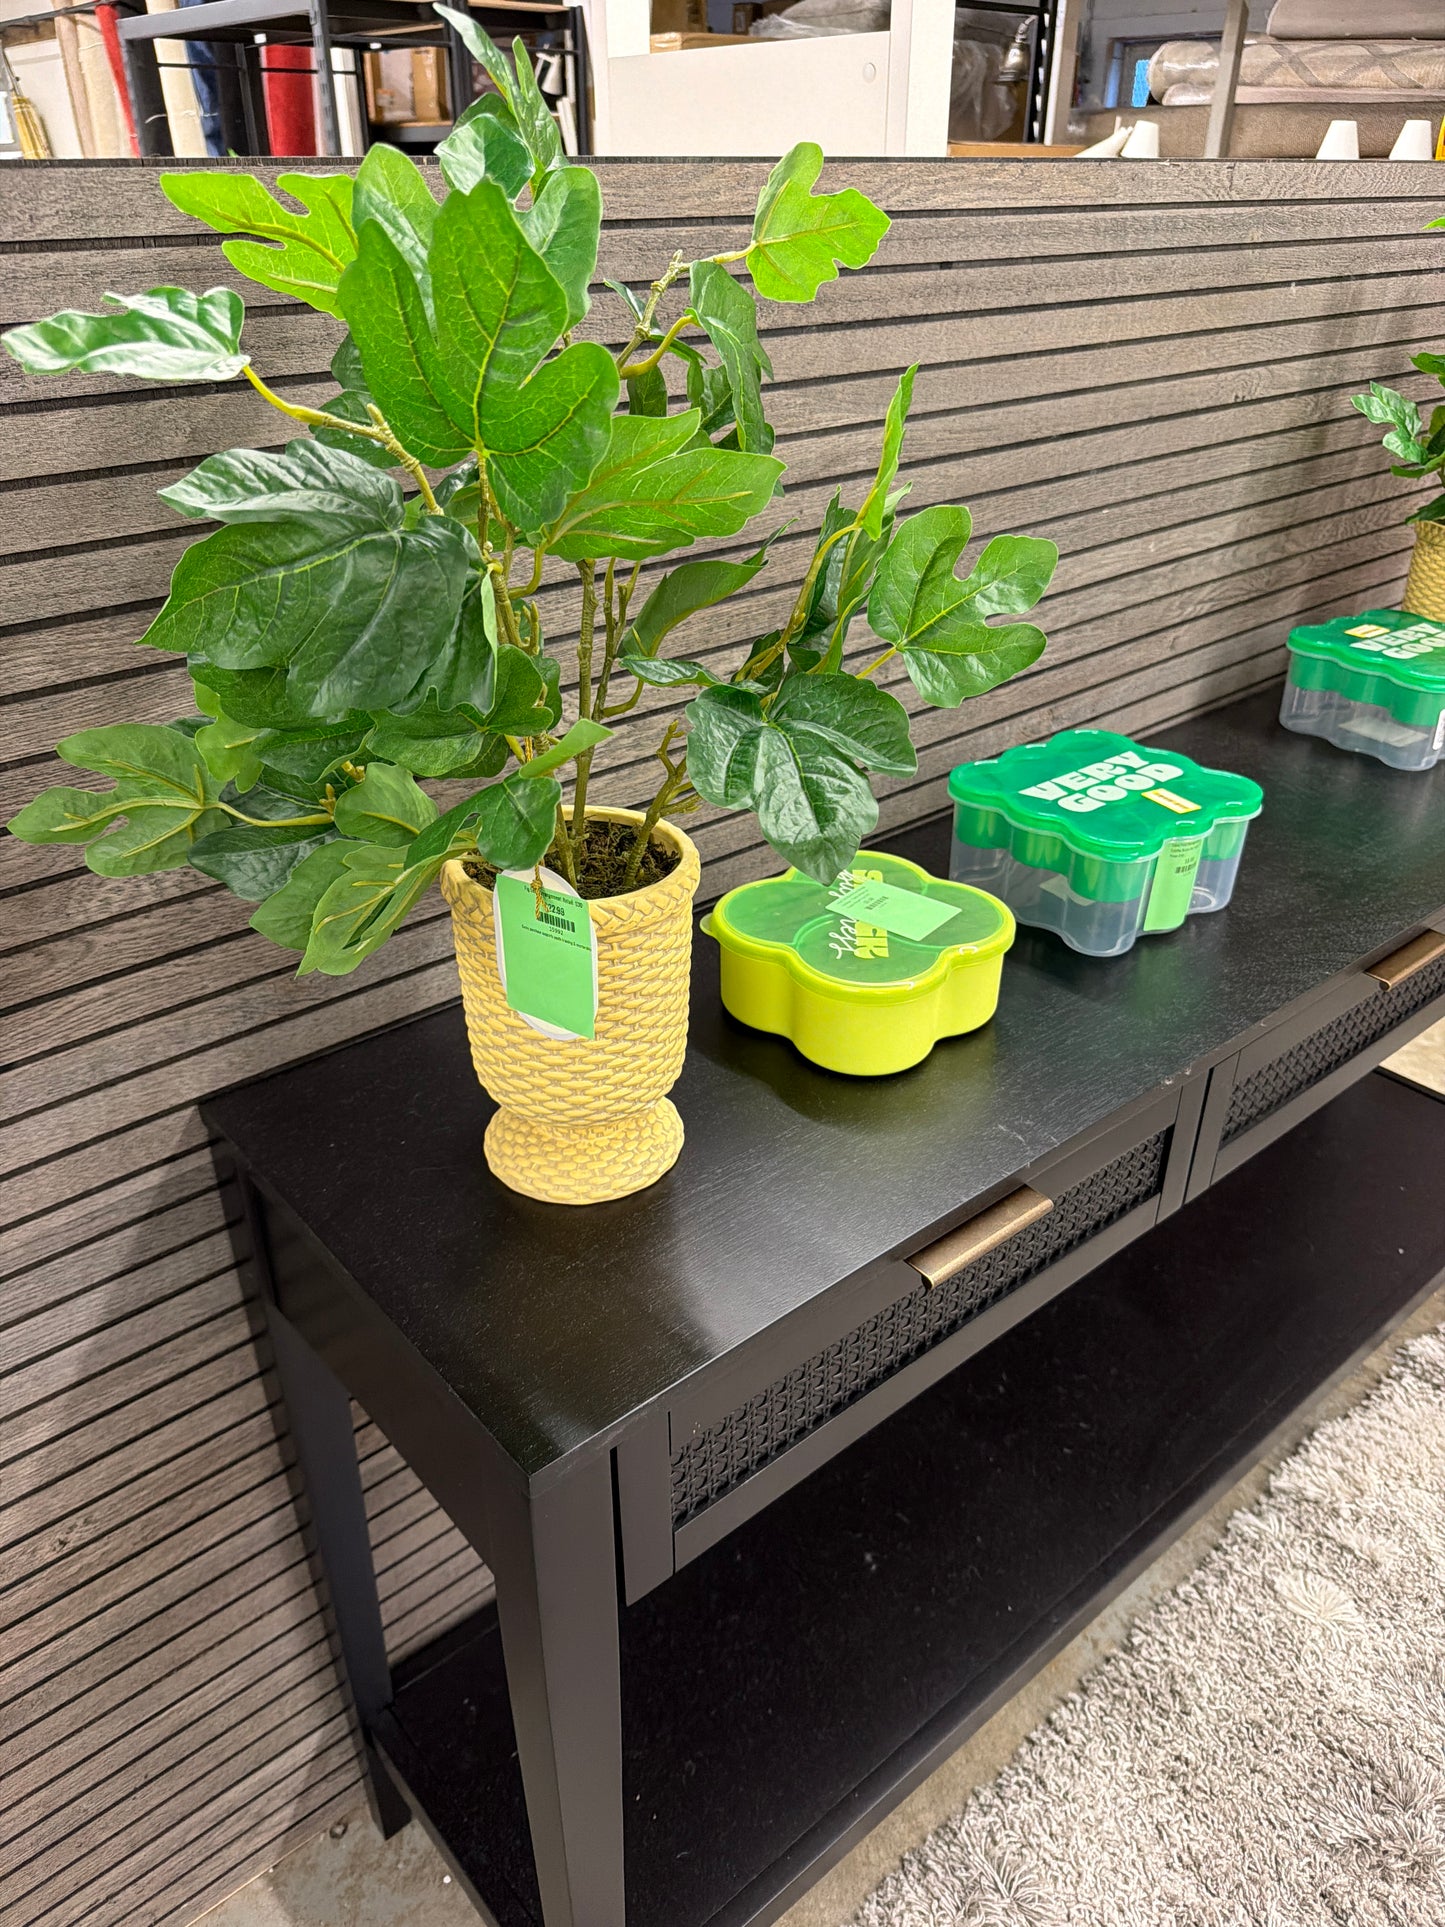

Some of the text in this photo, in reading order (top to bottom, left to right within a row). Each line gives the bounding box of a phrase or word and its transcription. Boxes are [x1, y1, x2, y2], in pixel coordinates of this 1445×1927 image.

[1349, 623, 1442, 652] VERY
[1382, 631, 1445, 660] GOO
[1018, 751, 1149, 801] VERY
[1058, 763, 1184, 813] GOOD
[852, 869, 890, 959] SCK
